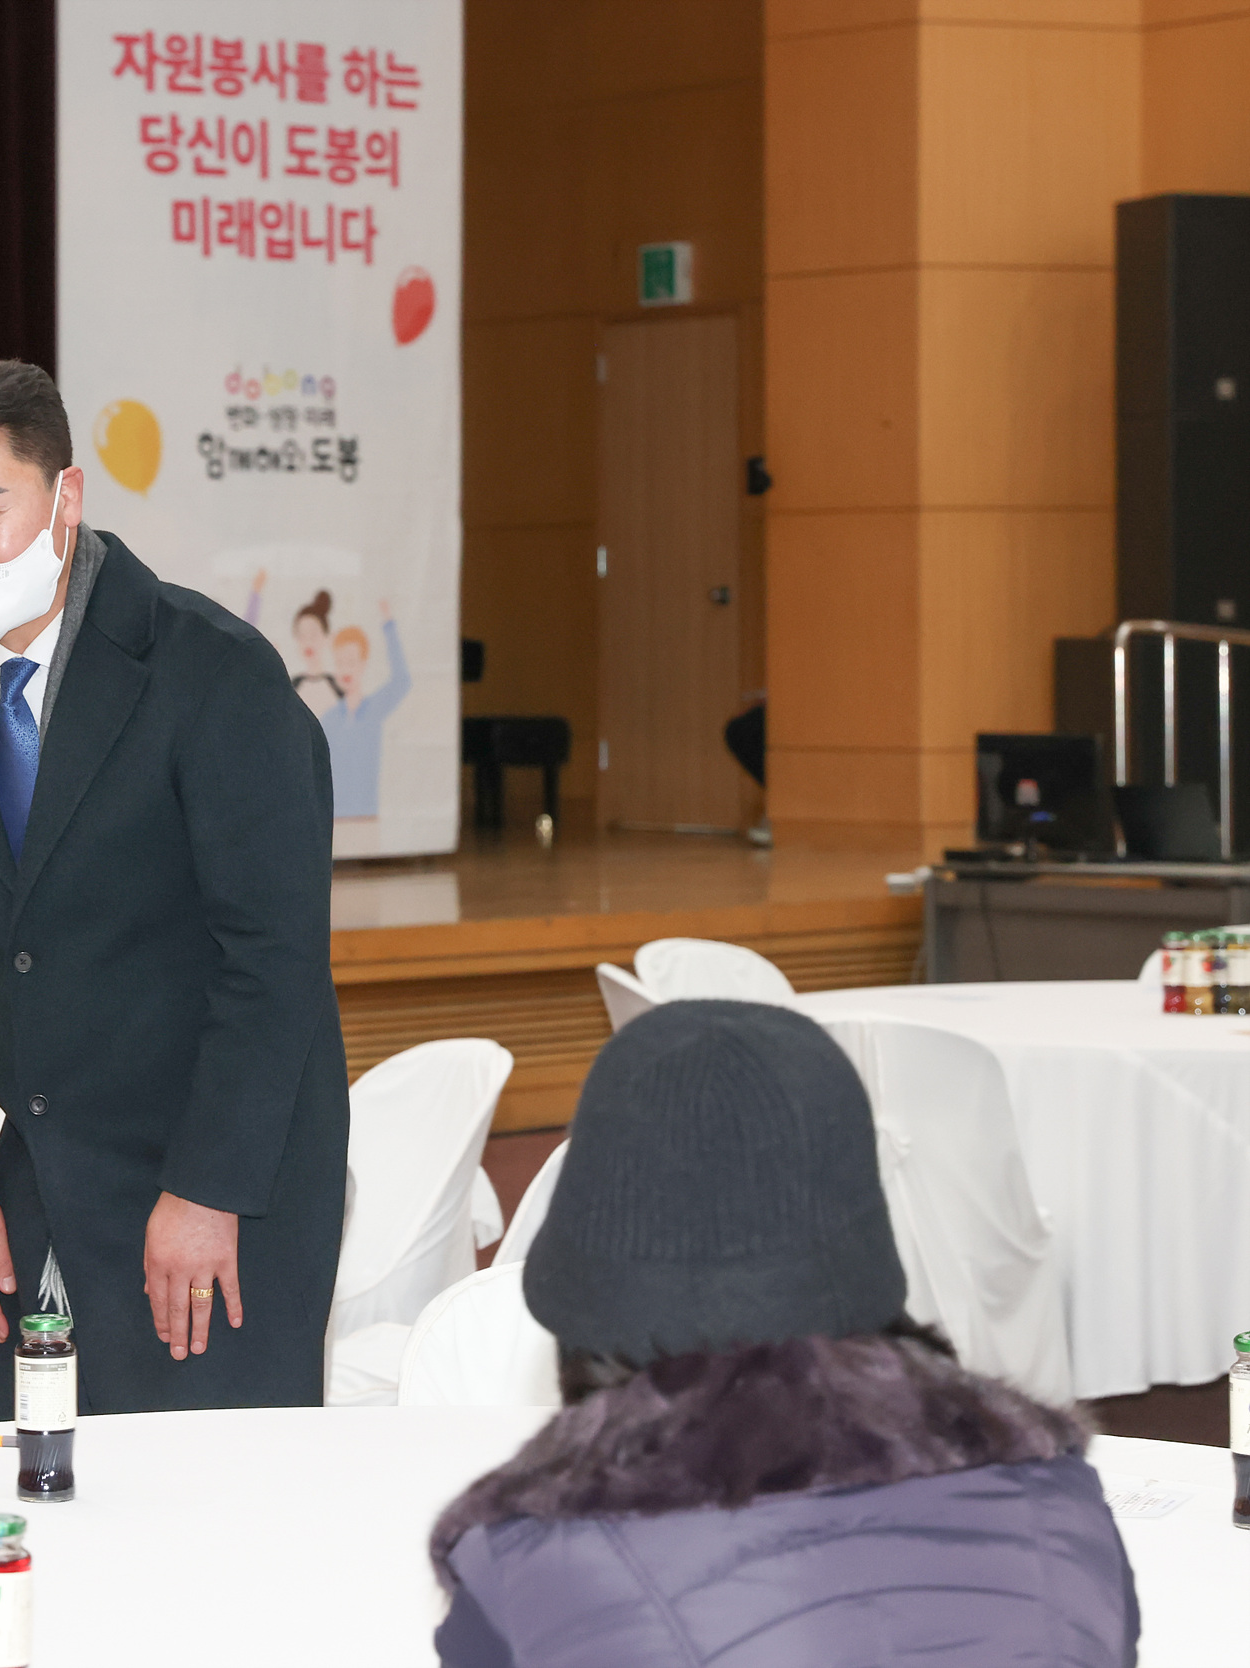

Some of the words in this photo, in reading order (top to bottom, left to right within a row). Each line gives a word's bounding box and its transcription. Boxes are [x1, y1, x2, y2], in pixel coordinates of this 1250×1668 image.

[112, 29, 329, 104] 자원봉사를
[342, 48, 421, 109] 하는
[140, 112, 268, 180] 당신이
[284, 124, 399, 188] 도봉의
[172, 196, 378, 265] 미래입니다
